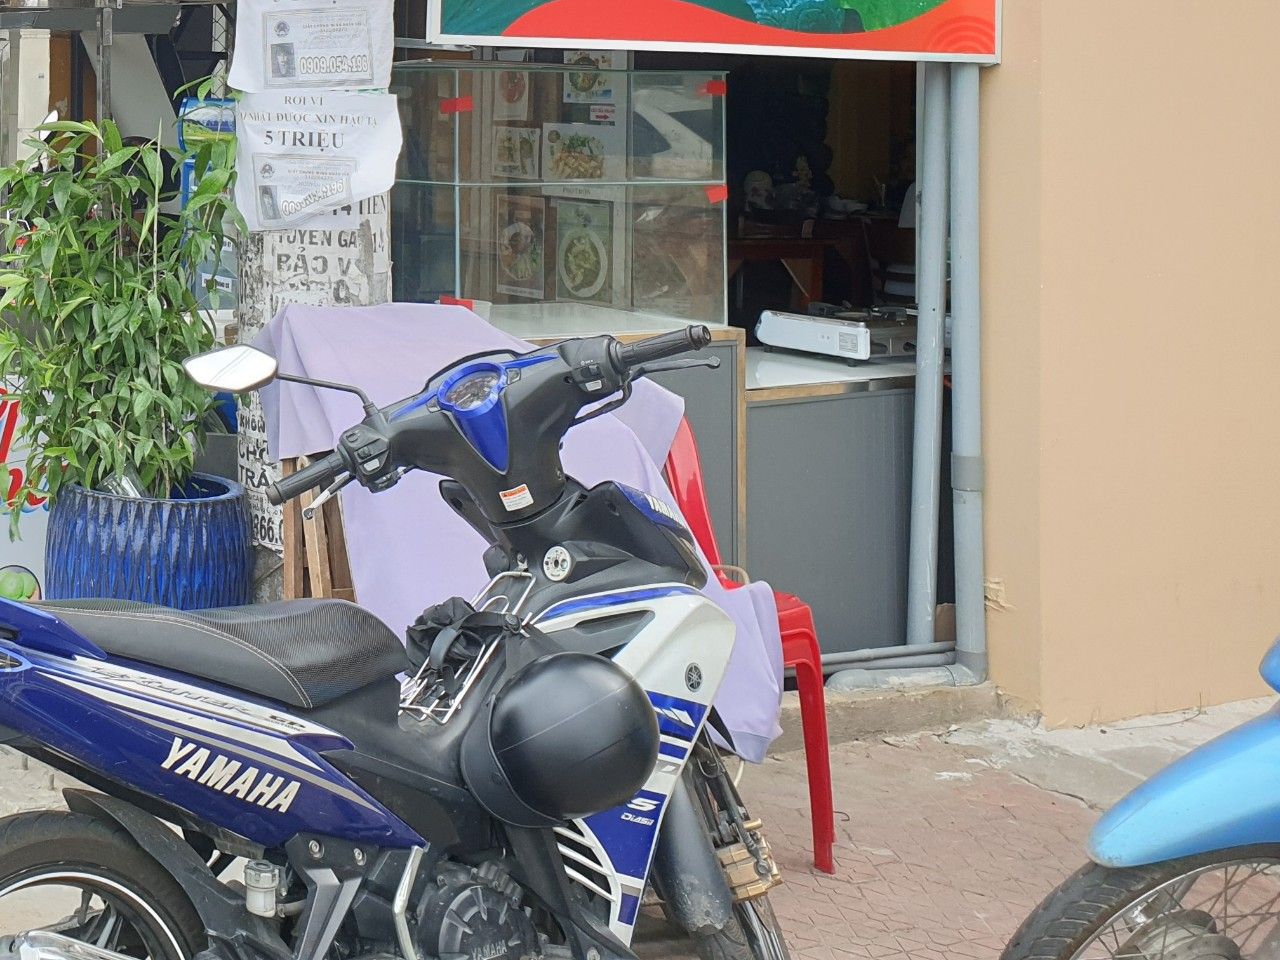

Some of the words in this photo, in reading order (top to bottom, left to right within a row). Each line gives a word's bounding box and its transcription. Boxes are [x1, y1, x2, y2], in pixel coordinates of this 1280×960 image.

[264, 129, 273, 146] 5
[277, 129, 345, 152] TRIỆU
[160, 736, 302, 814] YAMAHA
